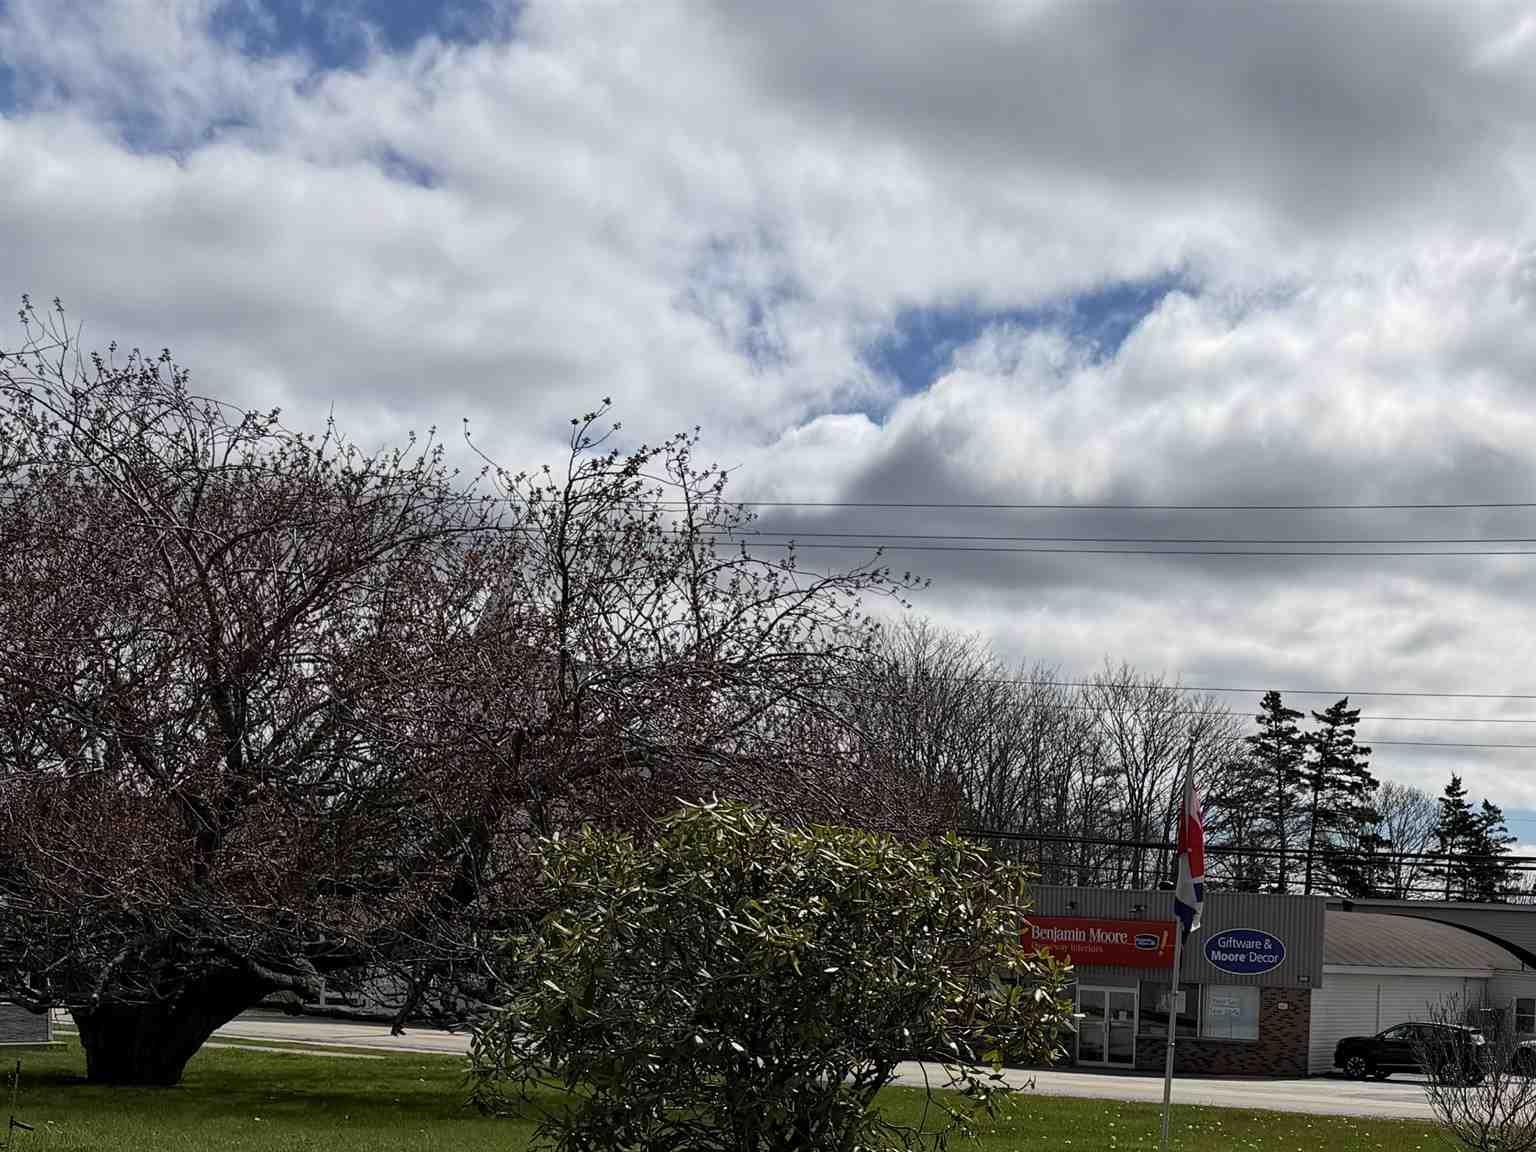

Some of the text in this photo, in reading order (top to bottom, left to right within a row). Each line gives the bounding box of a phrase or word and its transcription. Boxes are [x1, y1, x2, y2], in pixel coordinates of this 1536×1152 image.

[1031, 925, 1087, 943] Benjamin
[1088, 927, 1129, 944] Moore
[1217, 936, 1273, 950] Giftware &
[1210, 949, 1280, 963] Moore Decor
